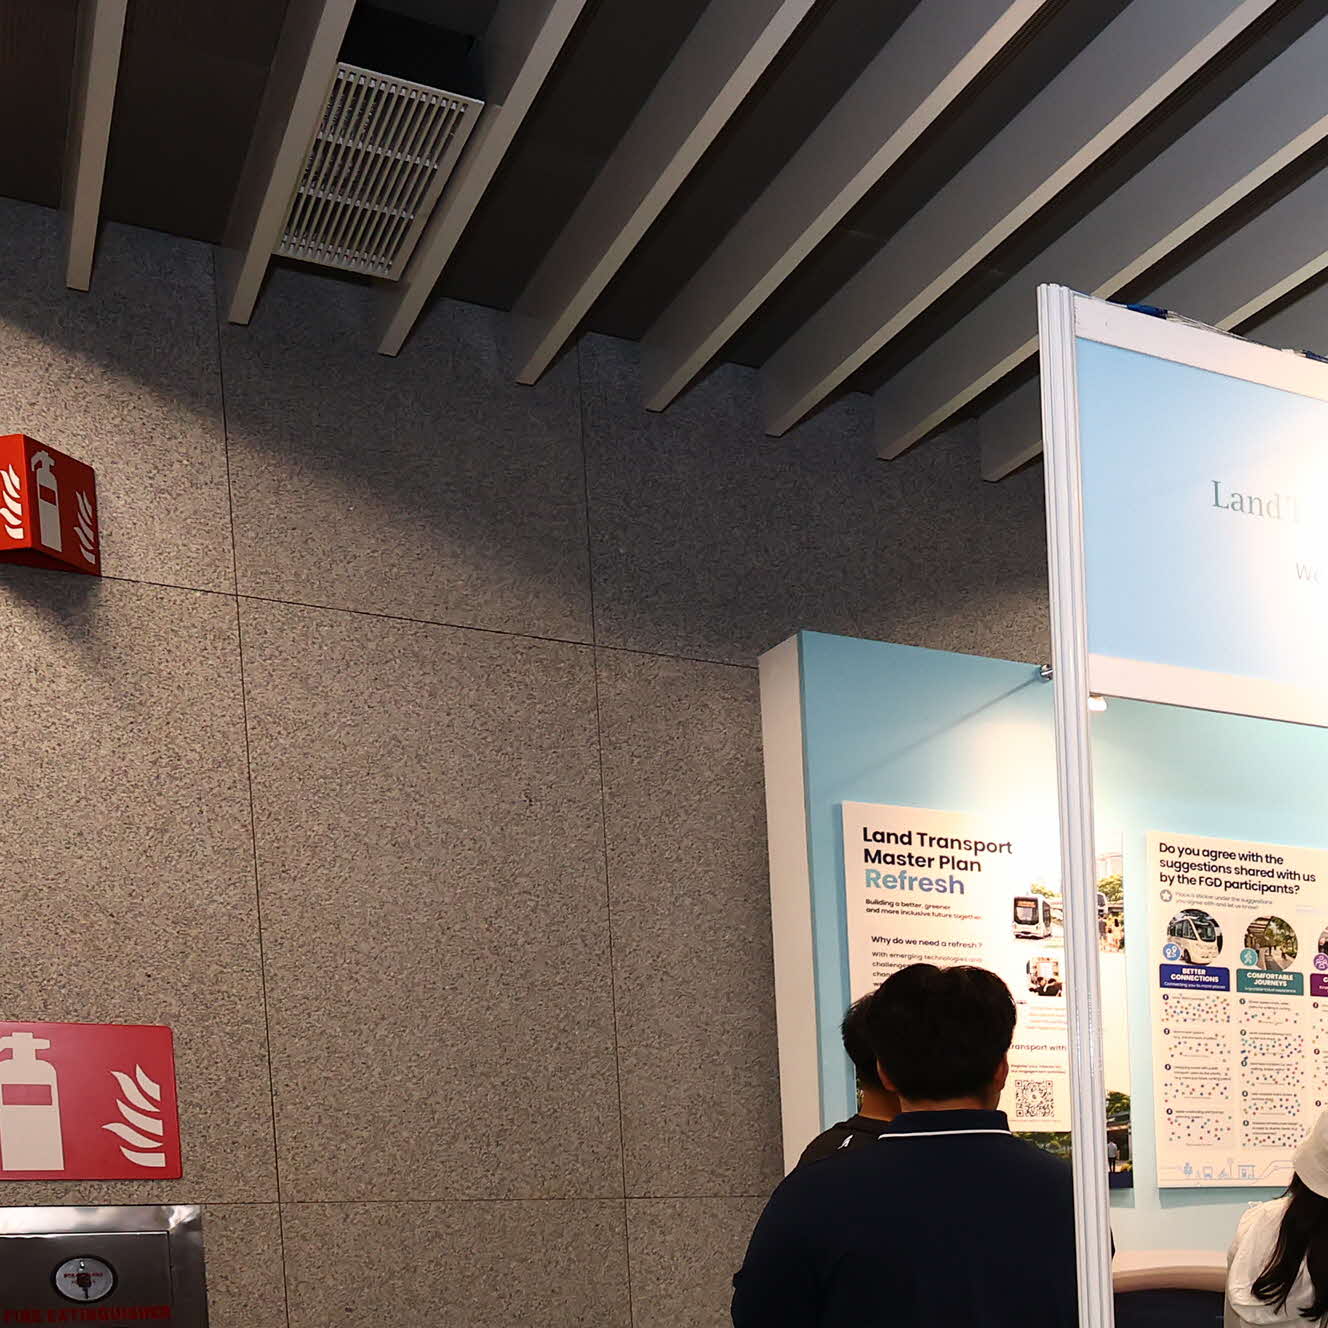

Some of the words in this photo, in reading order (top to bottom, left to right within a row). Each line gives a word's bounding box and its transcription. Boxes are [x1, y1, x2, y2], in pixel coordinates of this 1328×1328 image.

[1211, 479, 1282, 522] Land
[863, 827, 912, 846] Land
[916, 832, 1013, 856] Transport
[1159, 842, 1175, 854] Do
[1177, 845, 1200, 858] you
[1202, 847, 1236, 861] agree
[1238, 850, 1263, 864] with
[1265, 853, 1284, 865] the
[864, 848, 935, 869] Master
[939, 855, 982, 872] Plan
[1159, 858, 1232, 875] suggestions
[1234, 865, 1275, 879] shared
[1276, 869, 1301, 881] with
[1303, 873, 1316, 882] us
[865, 868, 965, 895] Refresh
[1159, 872, 1175, 887] by
[1177, 874, 1197, 886] the
[1199, 876, 1222, 888] FGD
[1224, 880, 1300, 895] participants?
[866, 898, 895, 908] Building
[900, 909, 931, 917] inclusive
[871, 936, 891, 945] Why
[892, 936, 903, 945] do
[918, 939, 940, 947] need
[889, 952, 923, 960] emerging
[1182, 967, 1207, 976] BETTER
[1247, 972, 1294, 981] COMFORTABLE
[1170, 973, 1219, 984] CONNECTIONS
[1253, 979, 1288, 988] JOURNEYS
